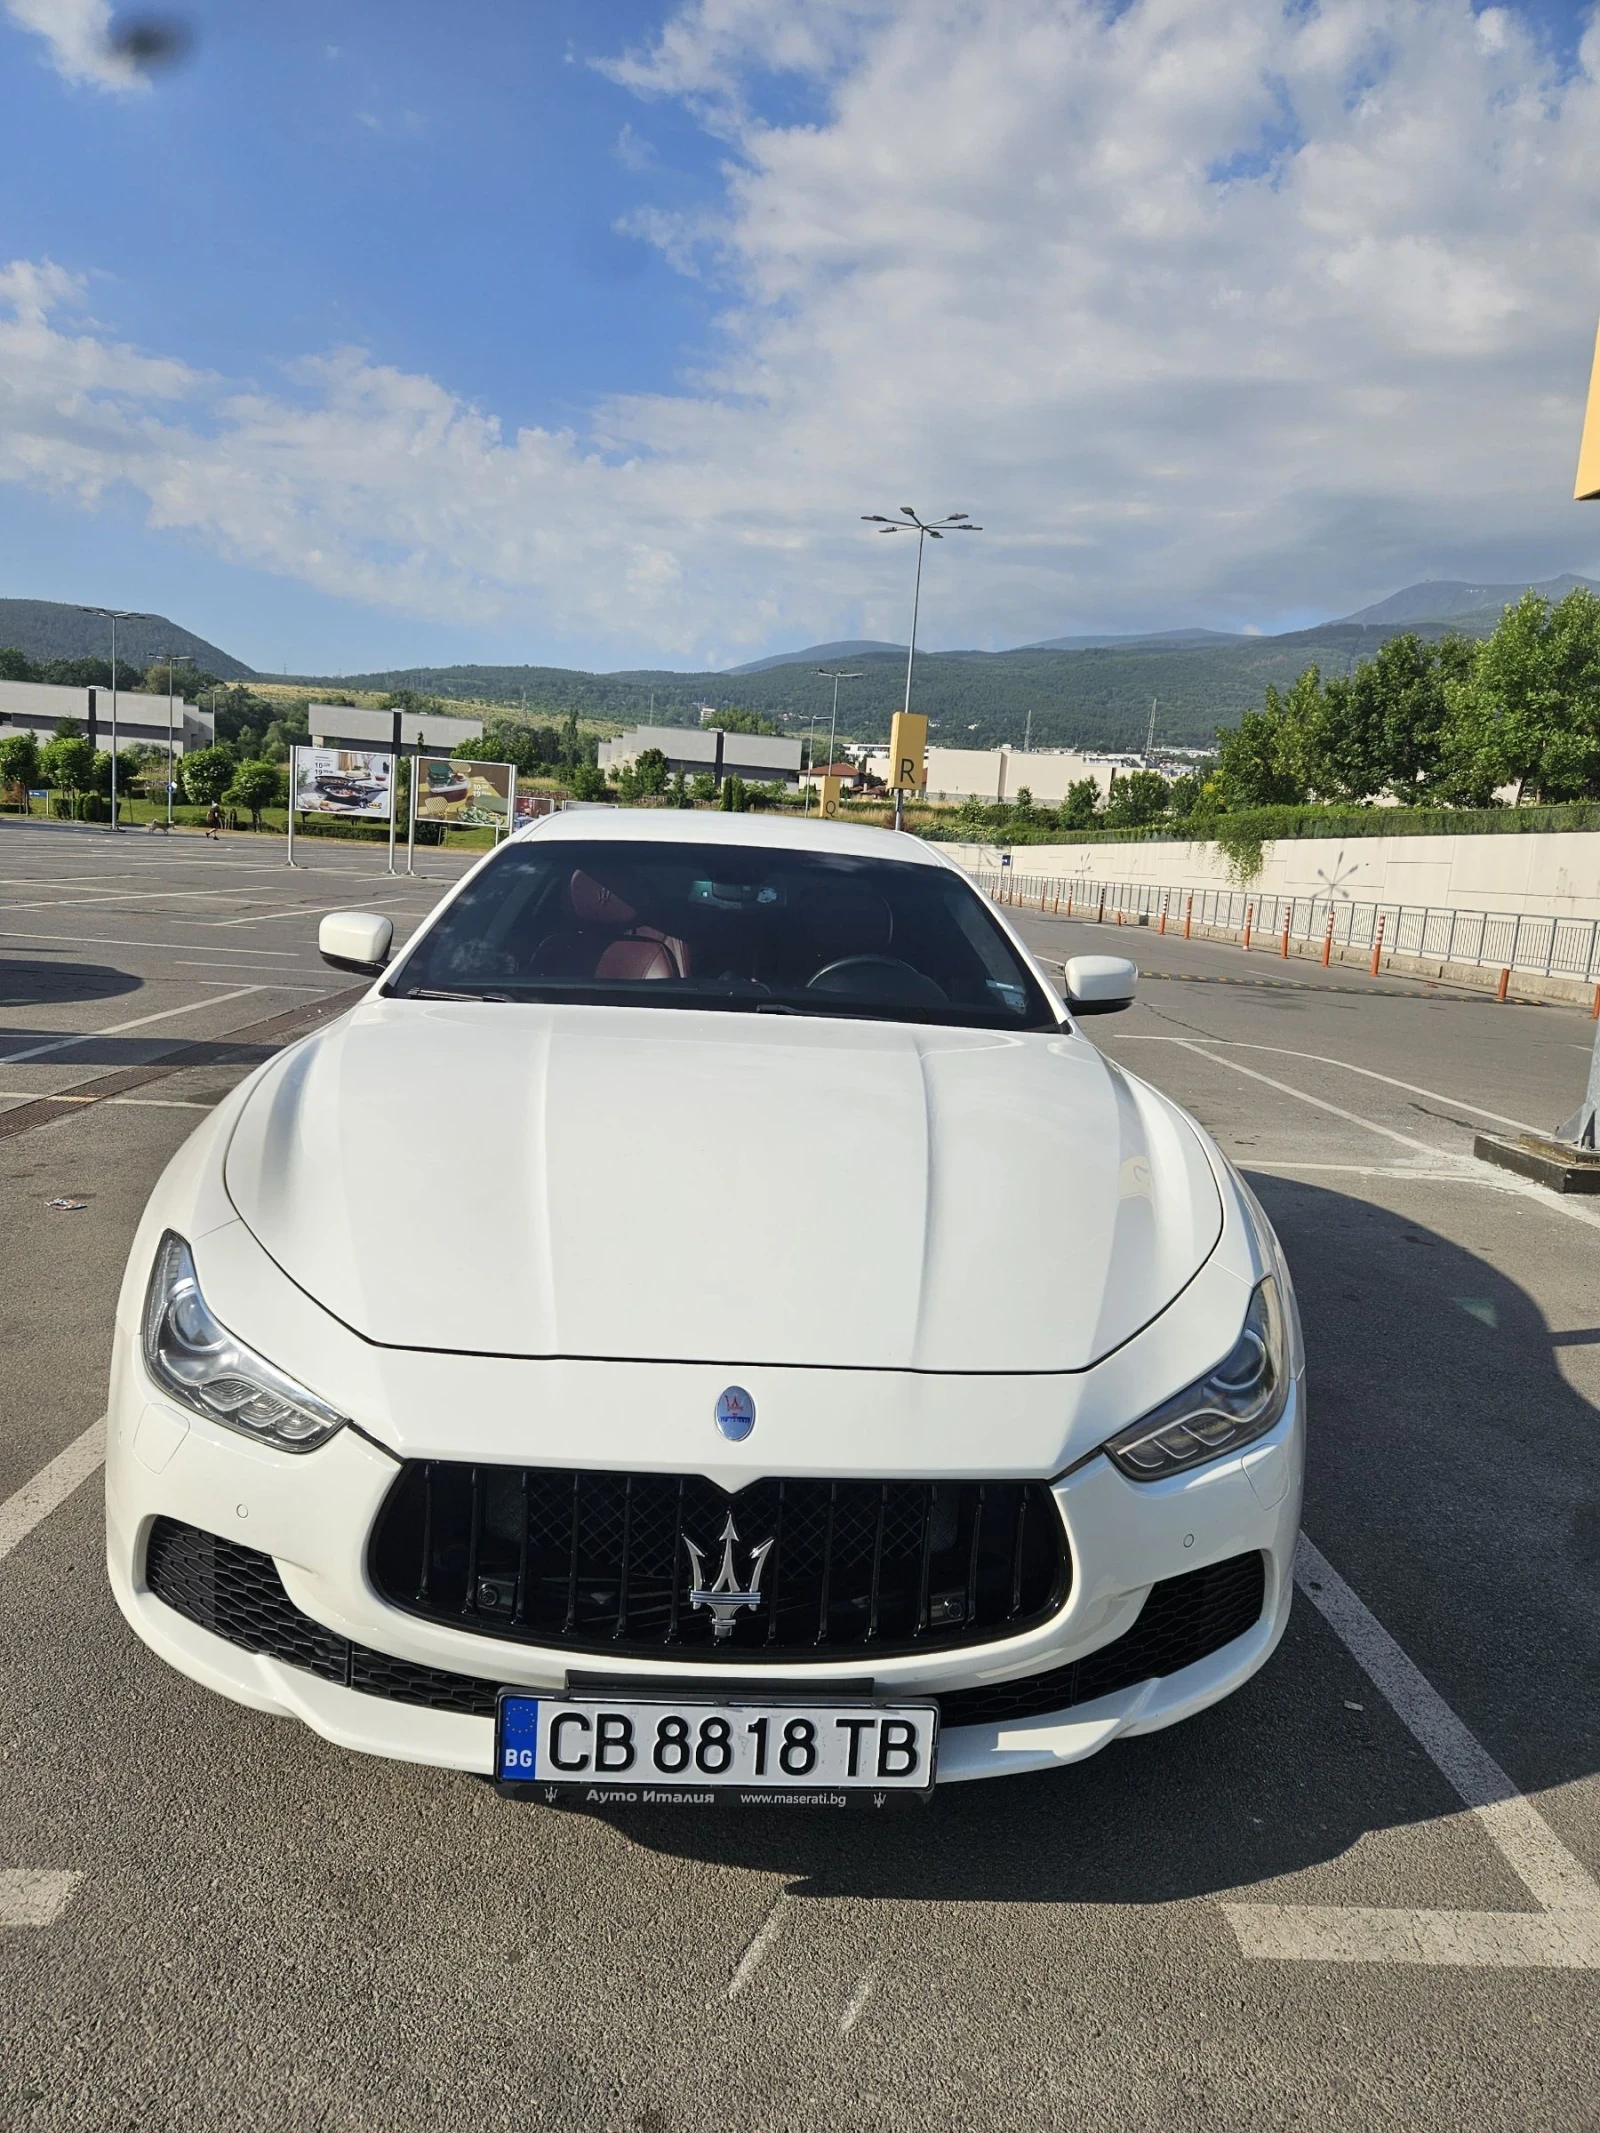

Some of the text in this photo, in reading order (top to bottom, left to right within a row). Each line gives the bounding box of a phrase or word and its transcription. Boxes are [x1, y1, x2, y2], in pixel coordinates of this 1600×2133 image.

[900, 758, 915, 784] R
[825, 800, 836, 818] Q
[549, 1712, 918, 1777] CB 8818 TB
[505, 1749, 532, 1767] BG
[586, 1789, 714, 1803] Ауто Италия
[740, 1793, 846, 1807] www.maserati.bg
